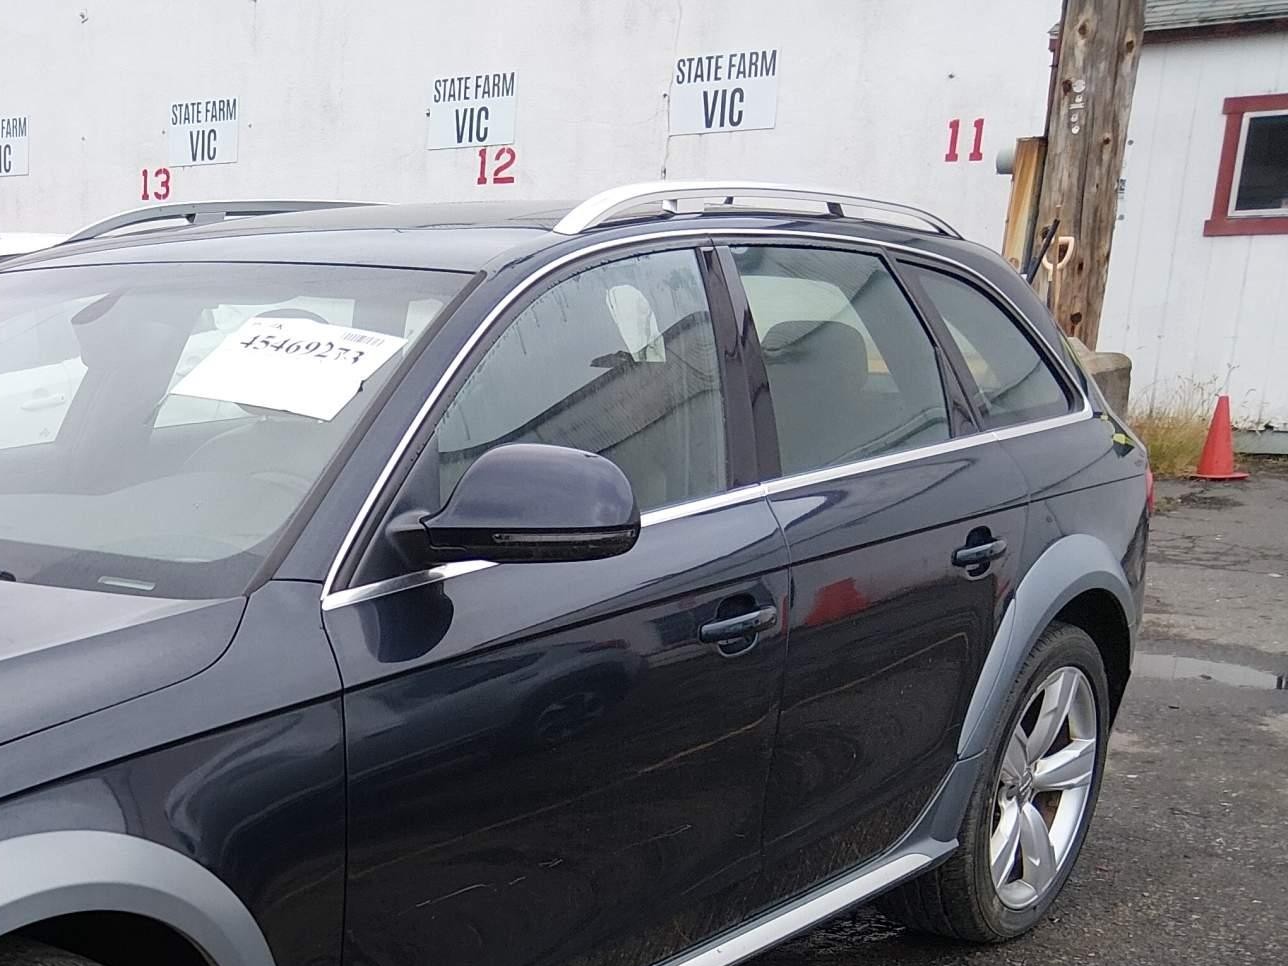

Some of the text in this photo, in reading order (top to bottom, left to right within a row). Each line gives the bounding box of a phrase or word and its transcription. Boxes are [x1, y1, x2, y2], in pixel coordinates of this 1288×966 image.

[675, 50, 777, 85] STATE FARM
[433, 72, 515, 103] STATE FARM
[171, 98, 237, 126] STATE FARM
[455, 106, 489, 144] VIC
[703, 87, 745, 129] VIC
[1, 116, 28, 139] FARM
[944, 118, 985, 162] 11
[189, 128, 217, 162] VIC
[476, 147, 517, 185] 12
[140, 167, 171, 201] 13
[240, 335, 365, 364] 45469273
